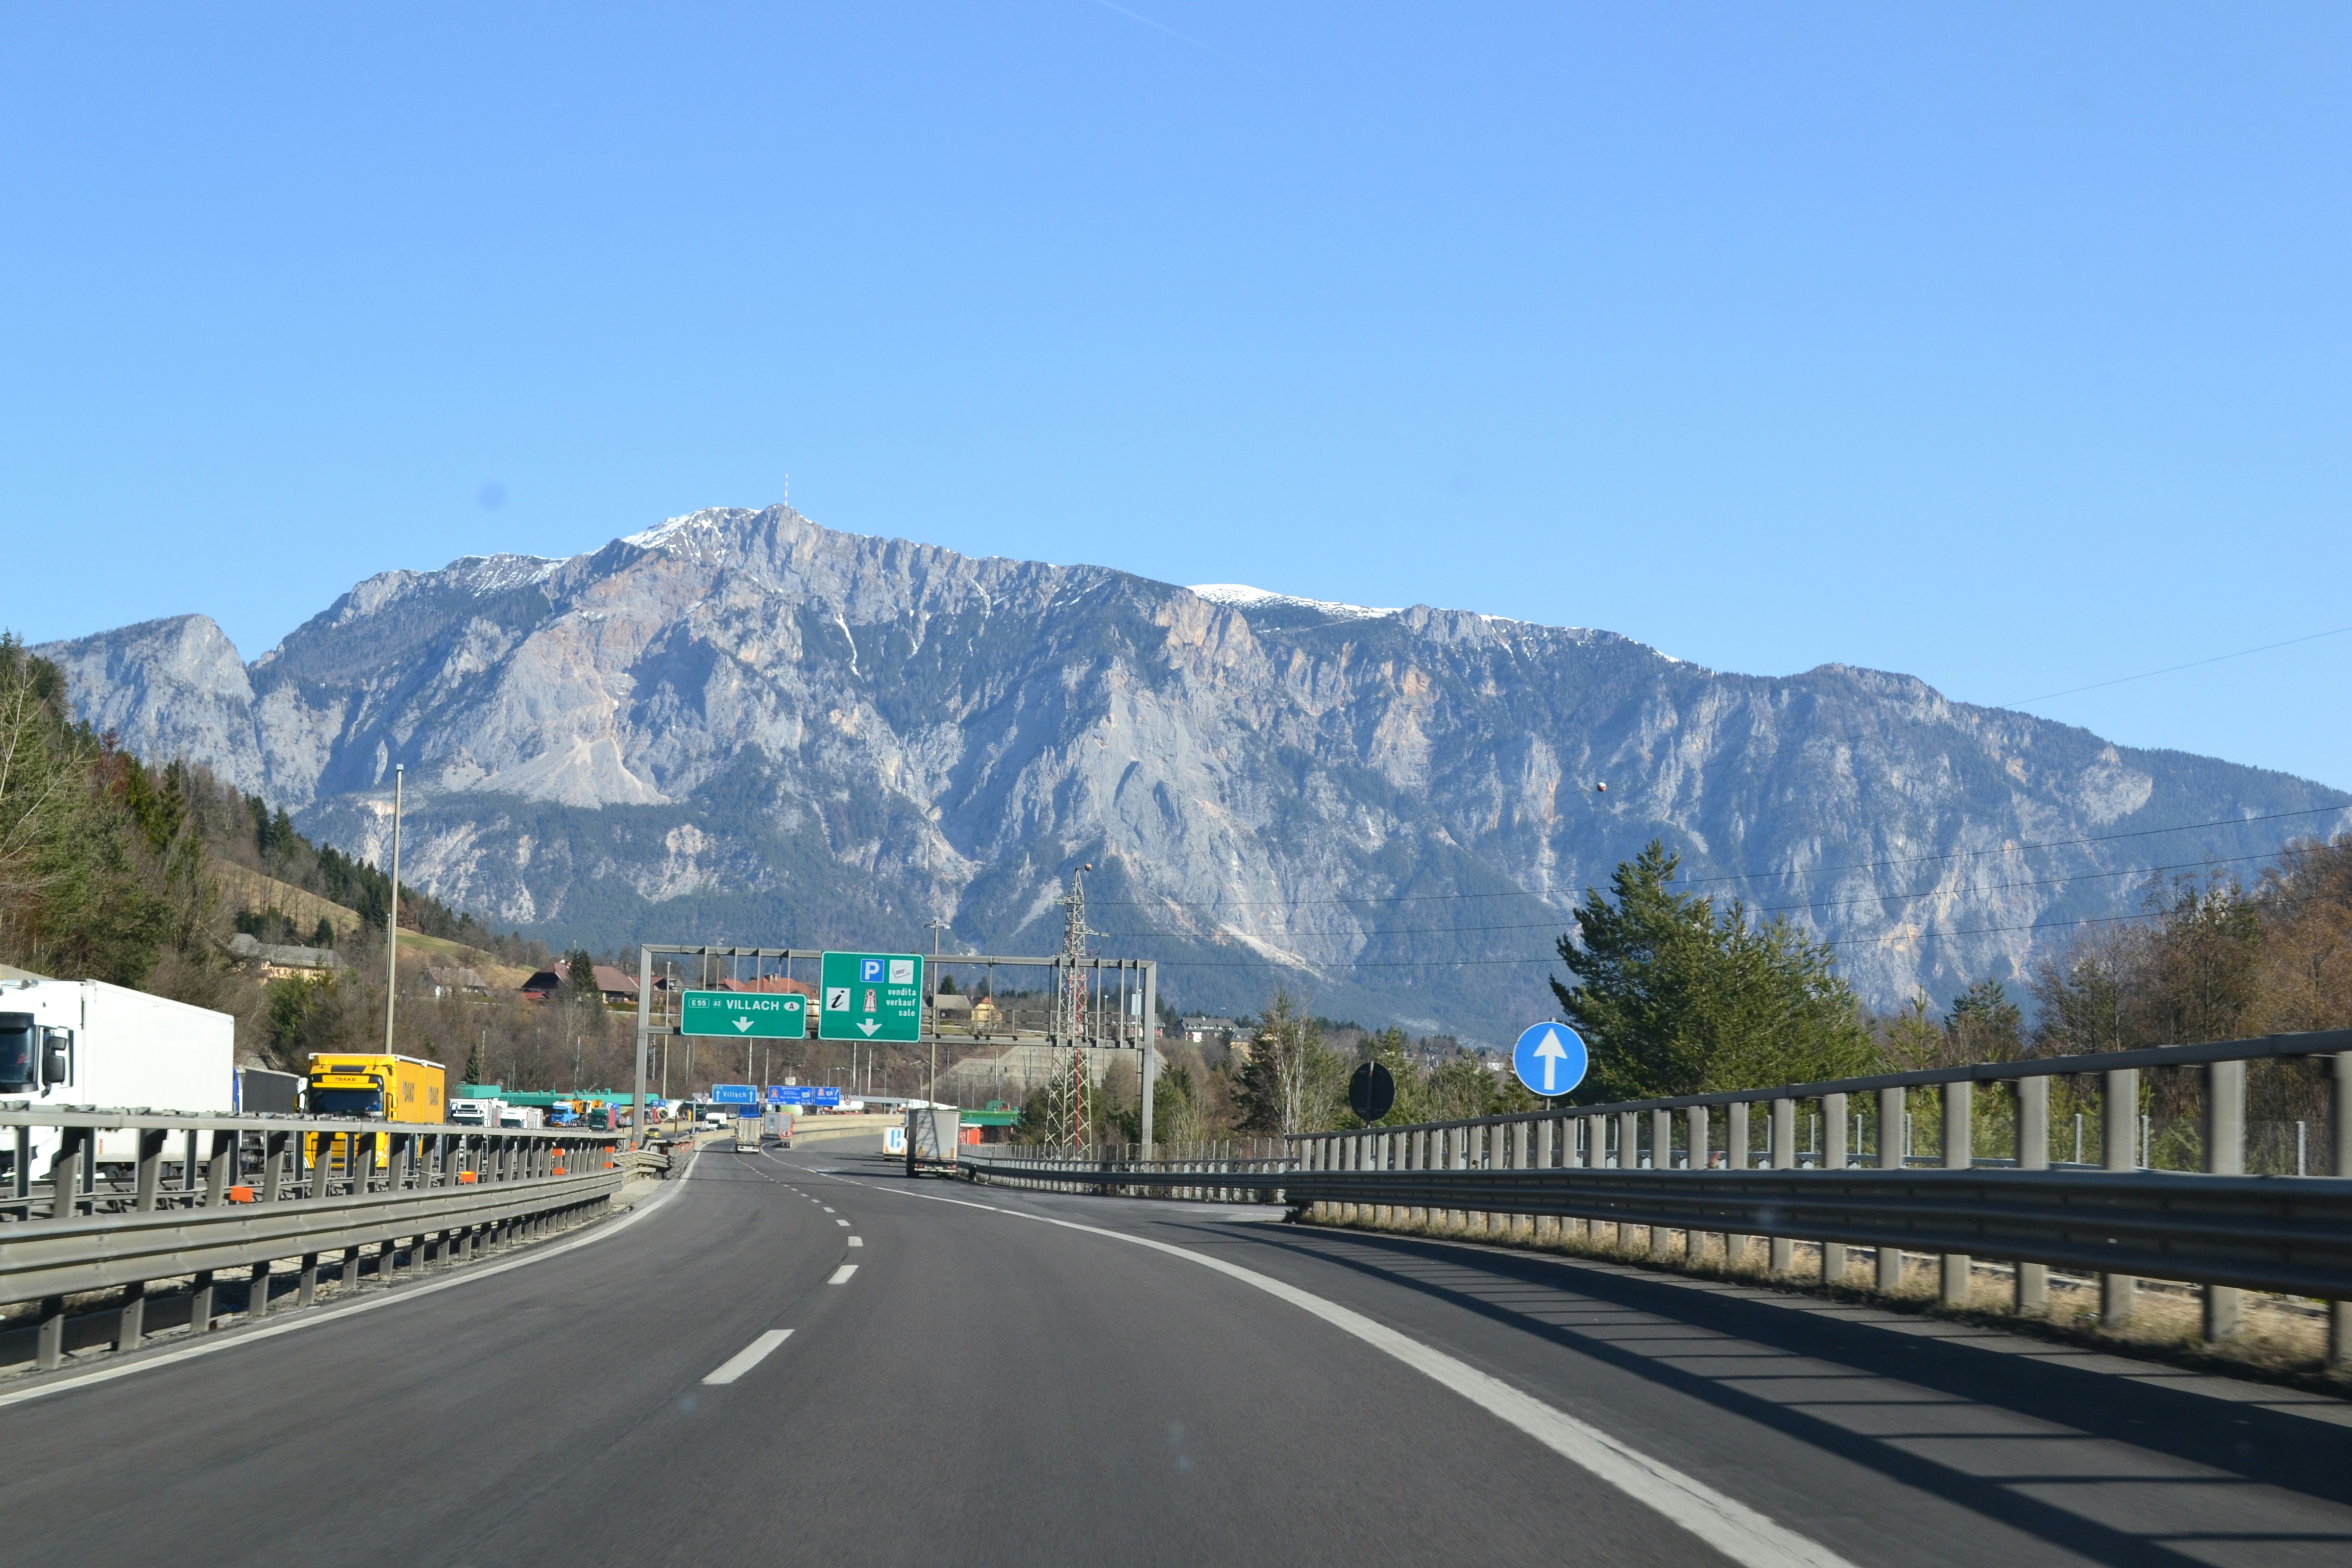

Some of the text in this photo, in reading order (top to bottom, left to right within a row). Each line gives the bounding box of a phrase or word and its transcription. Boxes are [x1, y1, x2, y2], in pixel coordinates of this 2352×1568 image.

[865, 961, 880, 980] P
[888, 988, 916, 996] vendita
[726, 999, 779, 1011] VILLACH
[886, 998, 916, 1007] verkauf
[898, 1009, 915, 1017] sale
